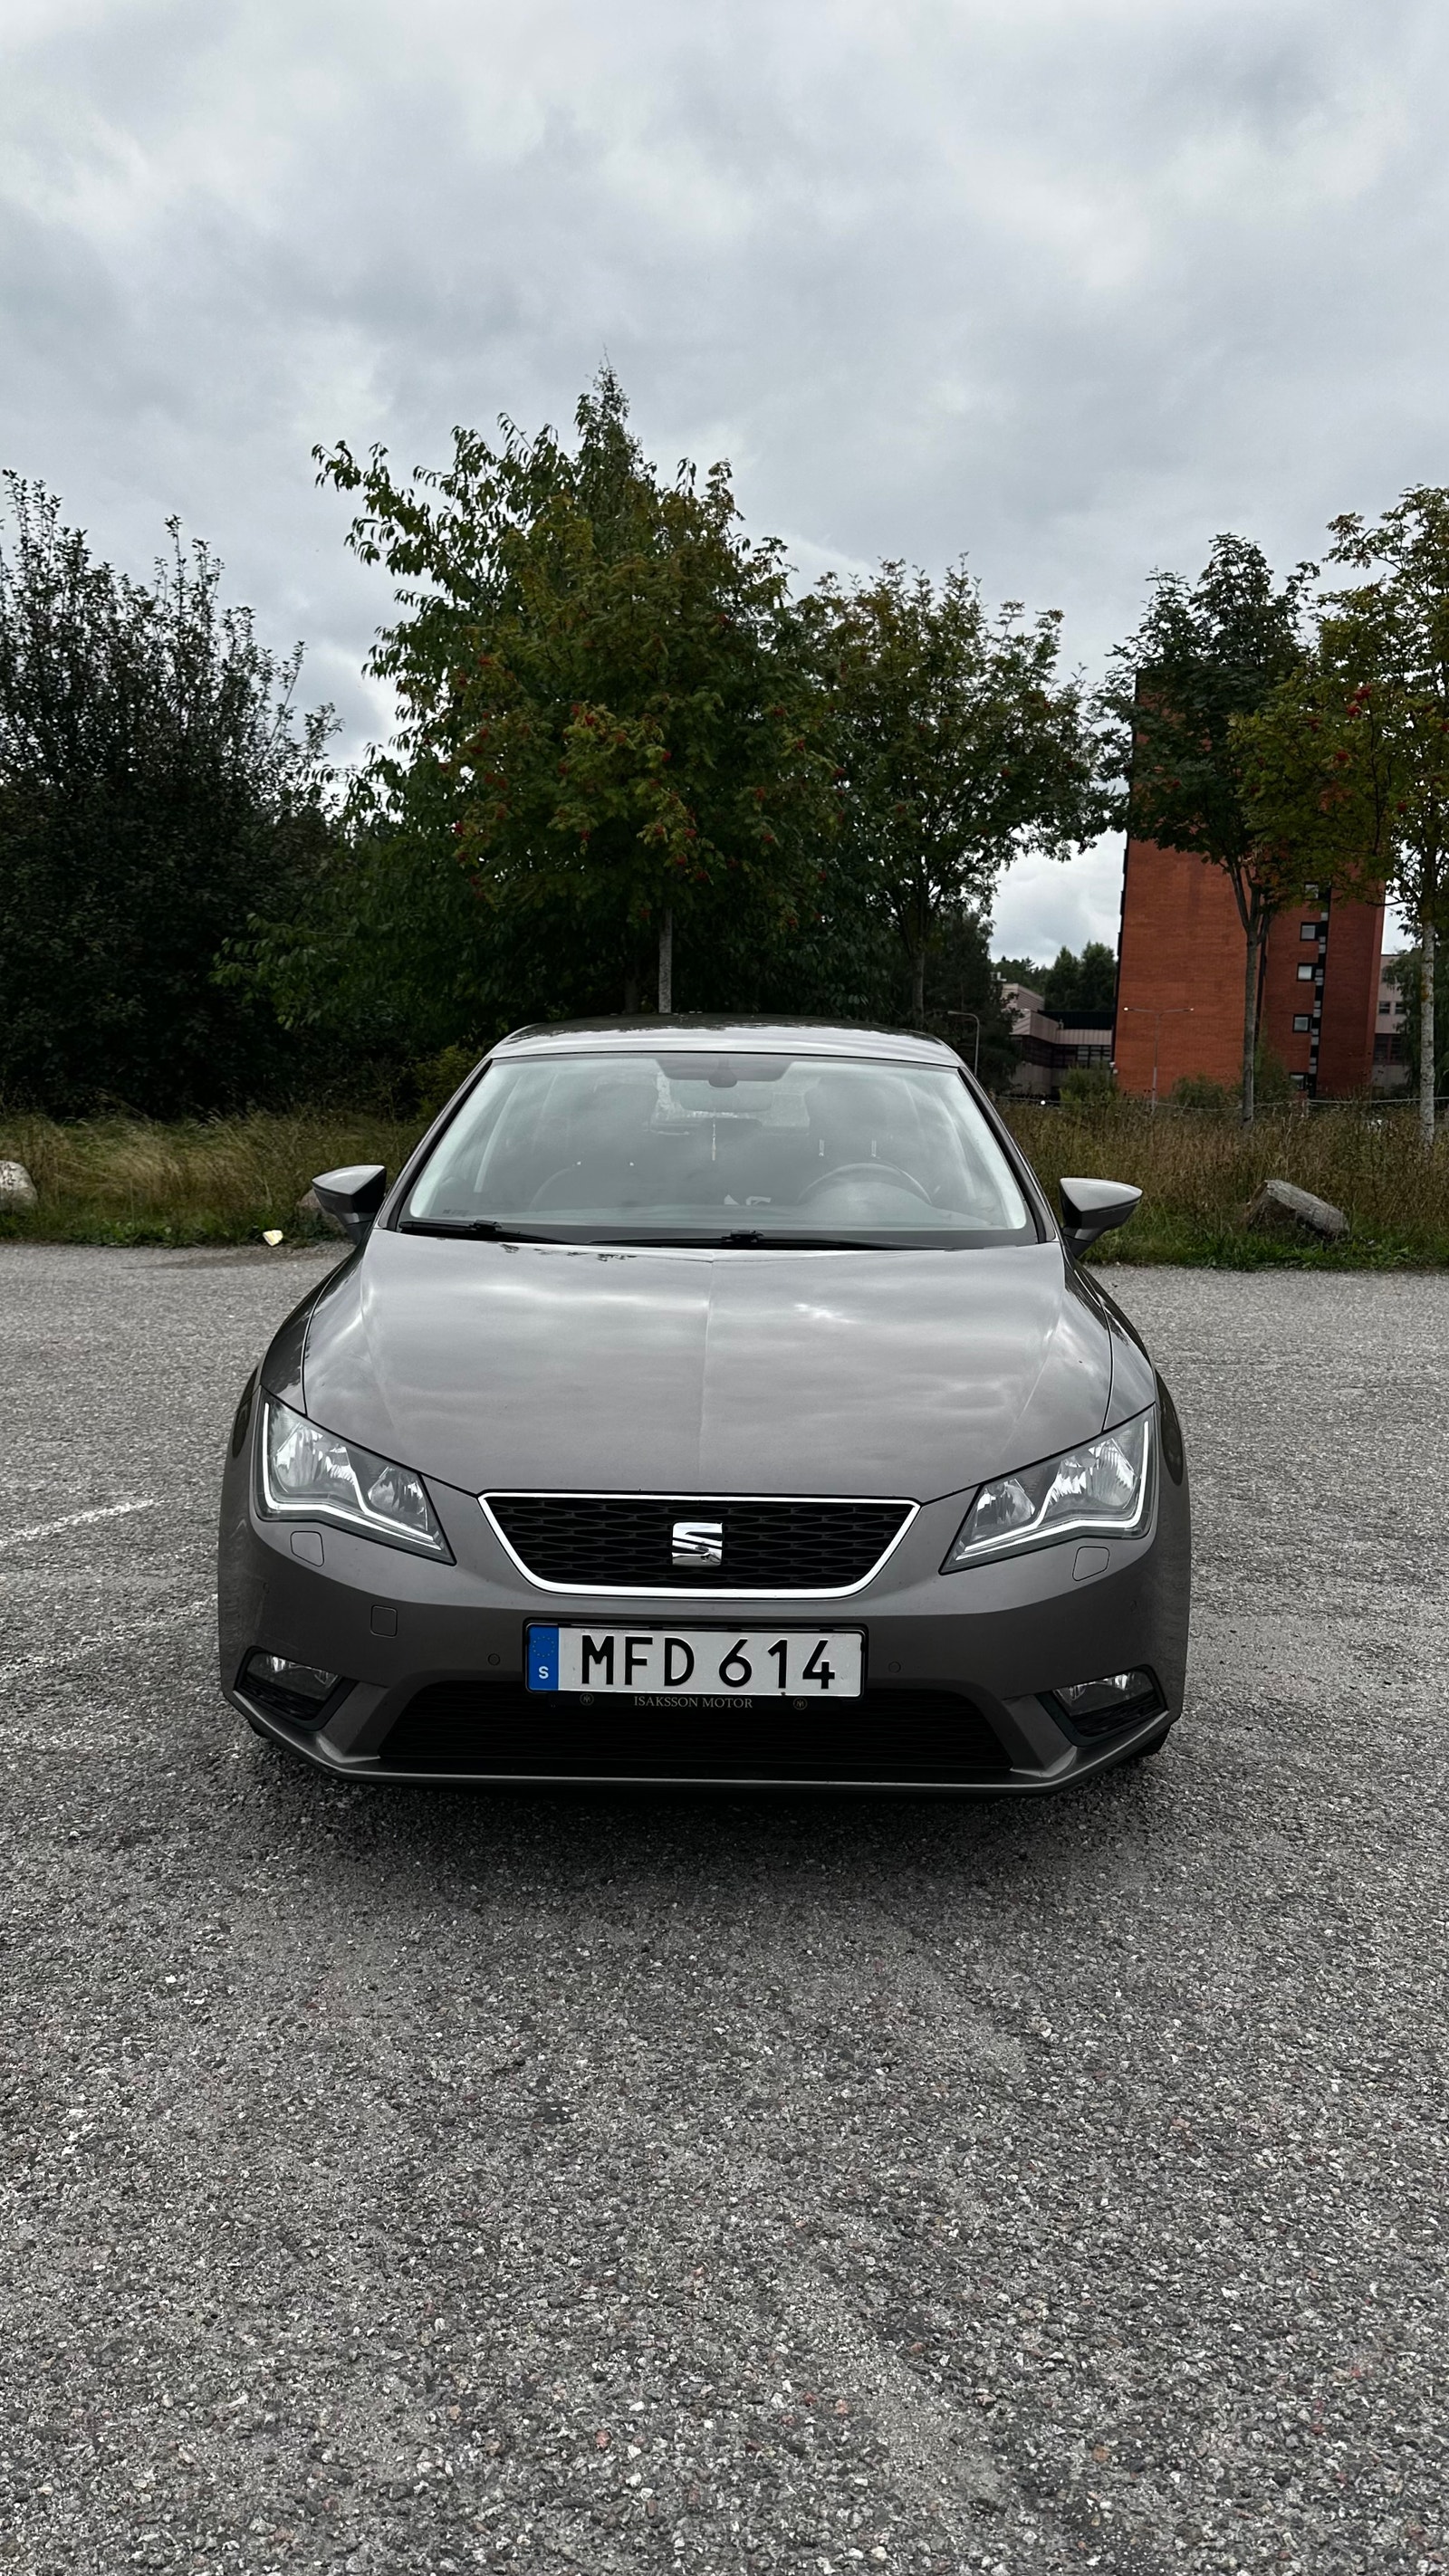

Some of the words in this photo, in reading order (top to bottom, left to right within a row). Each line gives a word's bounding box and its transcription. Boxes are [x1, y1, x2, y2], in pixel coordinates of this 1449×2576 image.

[581, 1634, 696, 1687] MFD
[718, 1638, 836, 1690] 614
[538, 1666, 549, 1680] S
[634, 1695, 698, 1708] ISAKSSON
[701, 1697, 753, 1709] MOTOR
